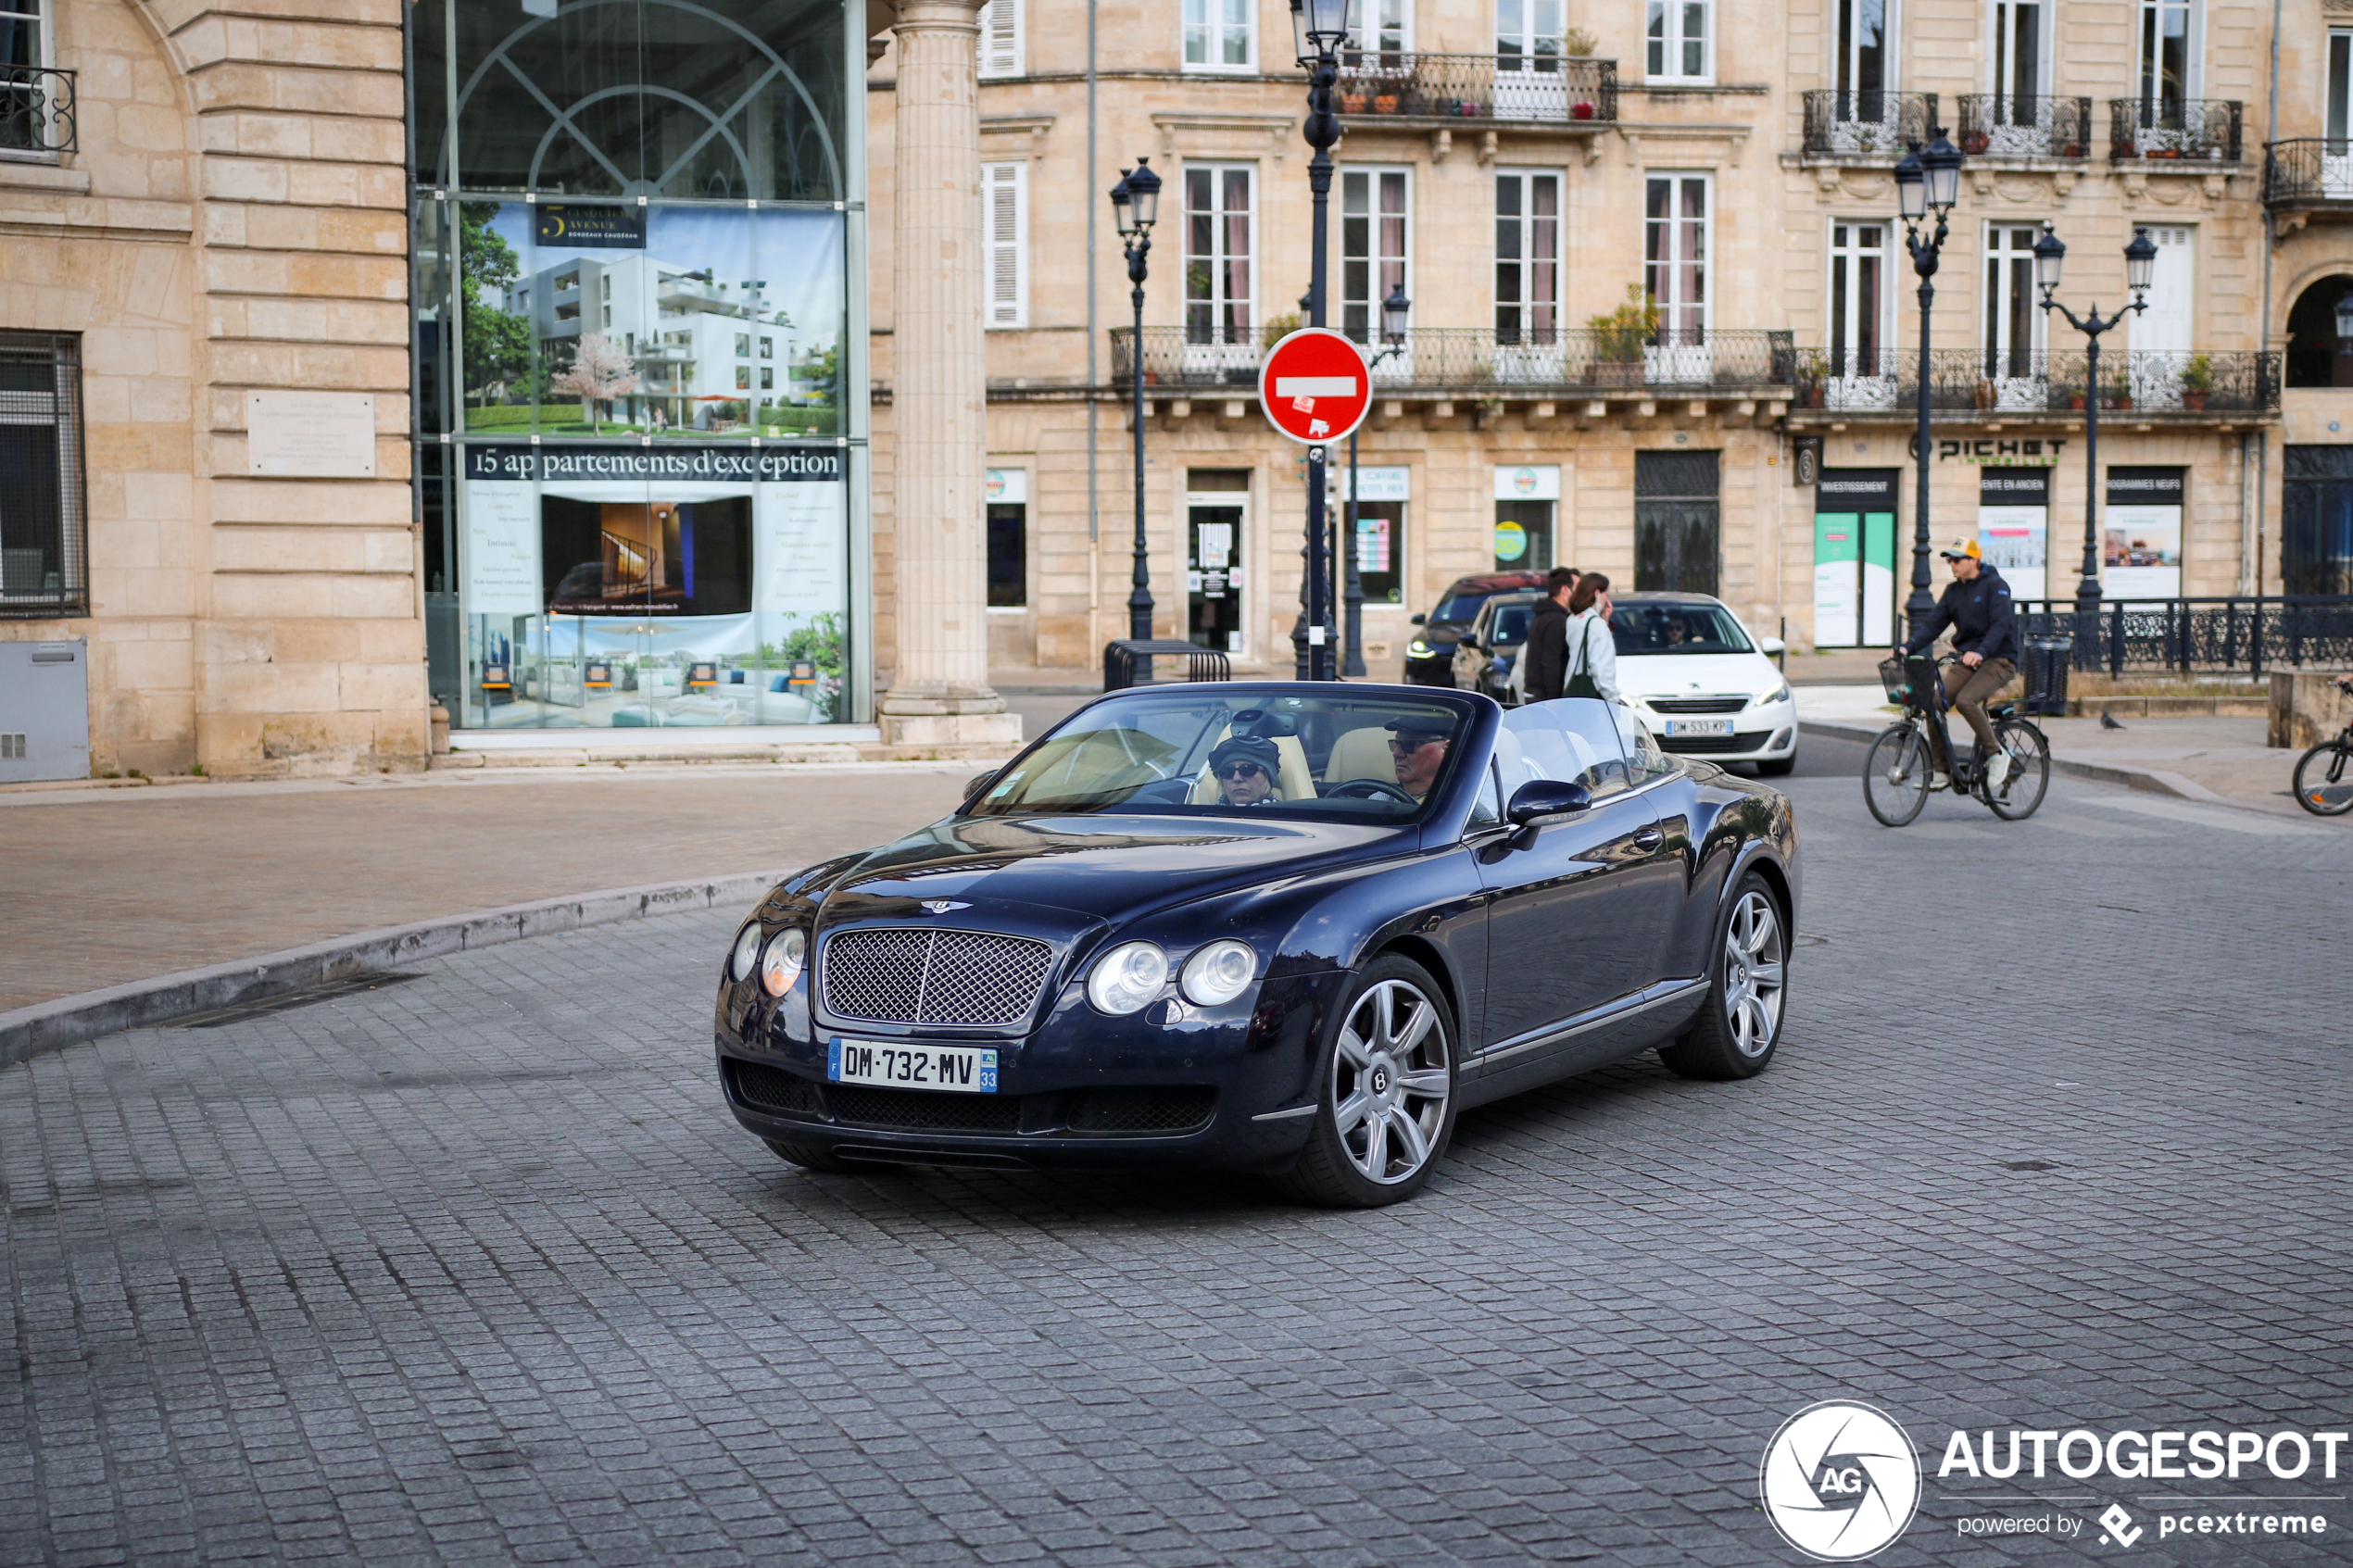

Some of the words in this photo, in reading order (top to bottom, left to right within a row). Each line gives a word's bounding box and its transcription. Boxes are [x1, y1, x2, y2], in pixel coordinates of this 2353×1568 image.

[542, 206, 565, 237] 5
[569, 220, 616, 230] AVENUE
[1940, 439, 2067, 462] PICHET
[475, 447, 497, 473] 15
[1820, 481, 1888, 493] INVESTISSEMENT
[2004, 479, 2015, 491] EN
[2015, 479, 2045, 491] ANCIEN
[2107, 479, 2154, 490] ROGRAMMES
[2156, 479, 2181, 490] NEUFS
[831, 1062, 837, 1073] F
[980, 1072, 997, 1087] 33
[1374, 1073, 1387, 1090] B
